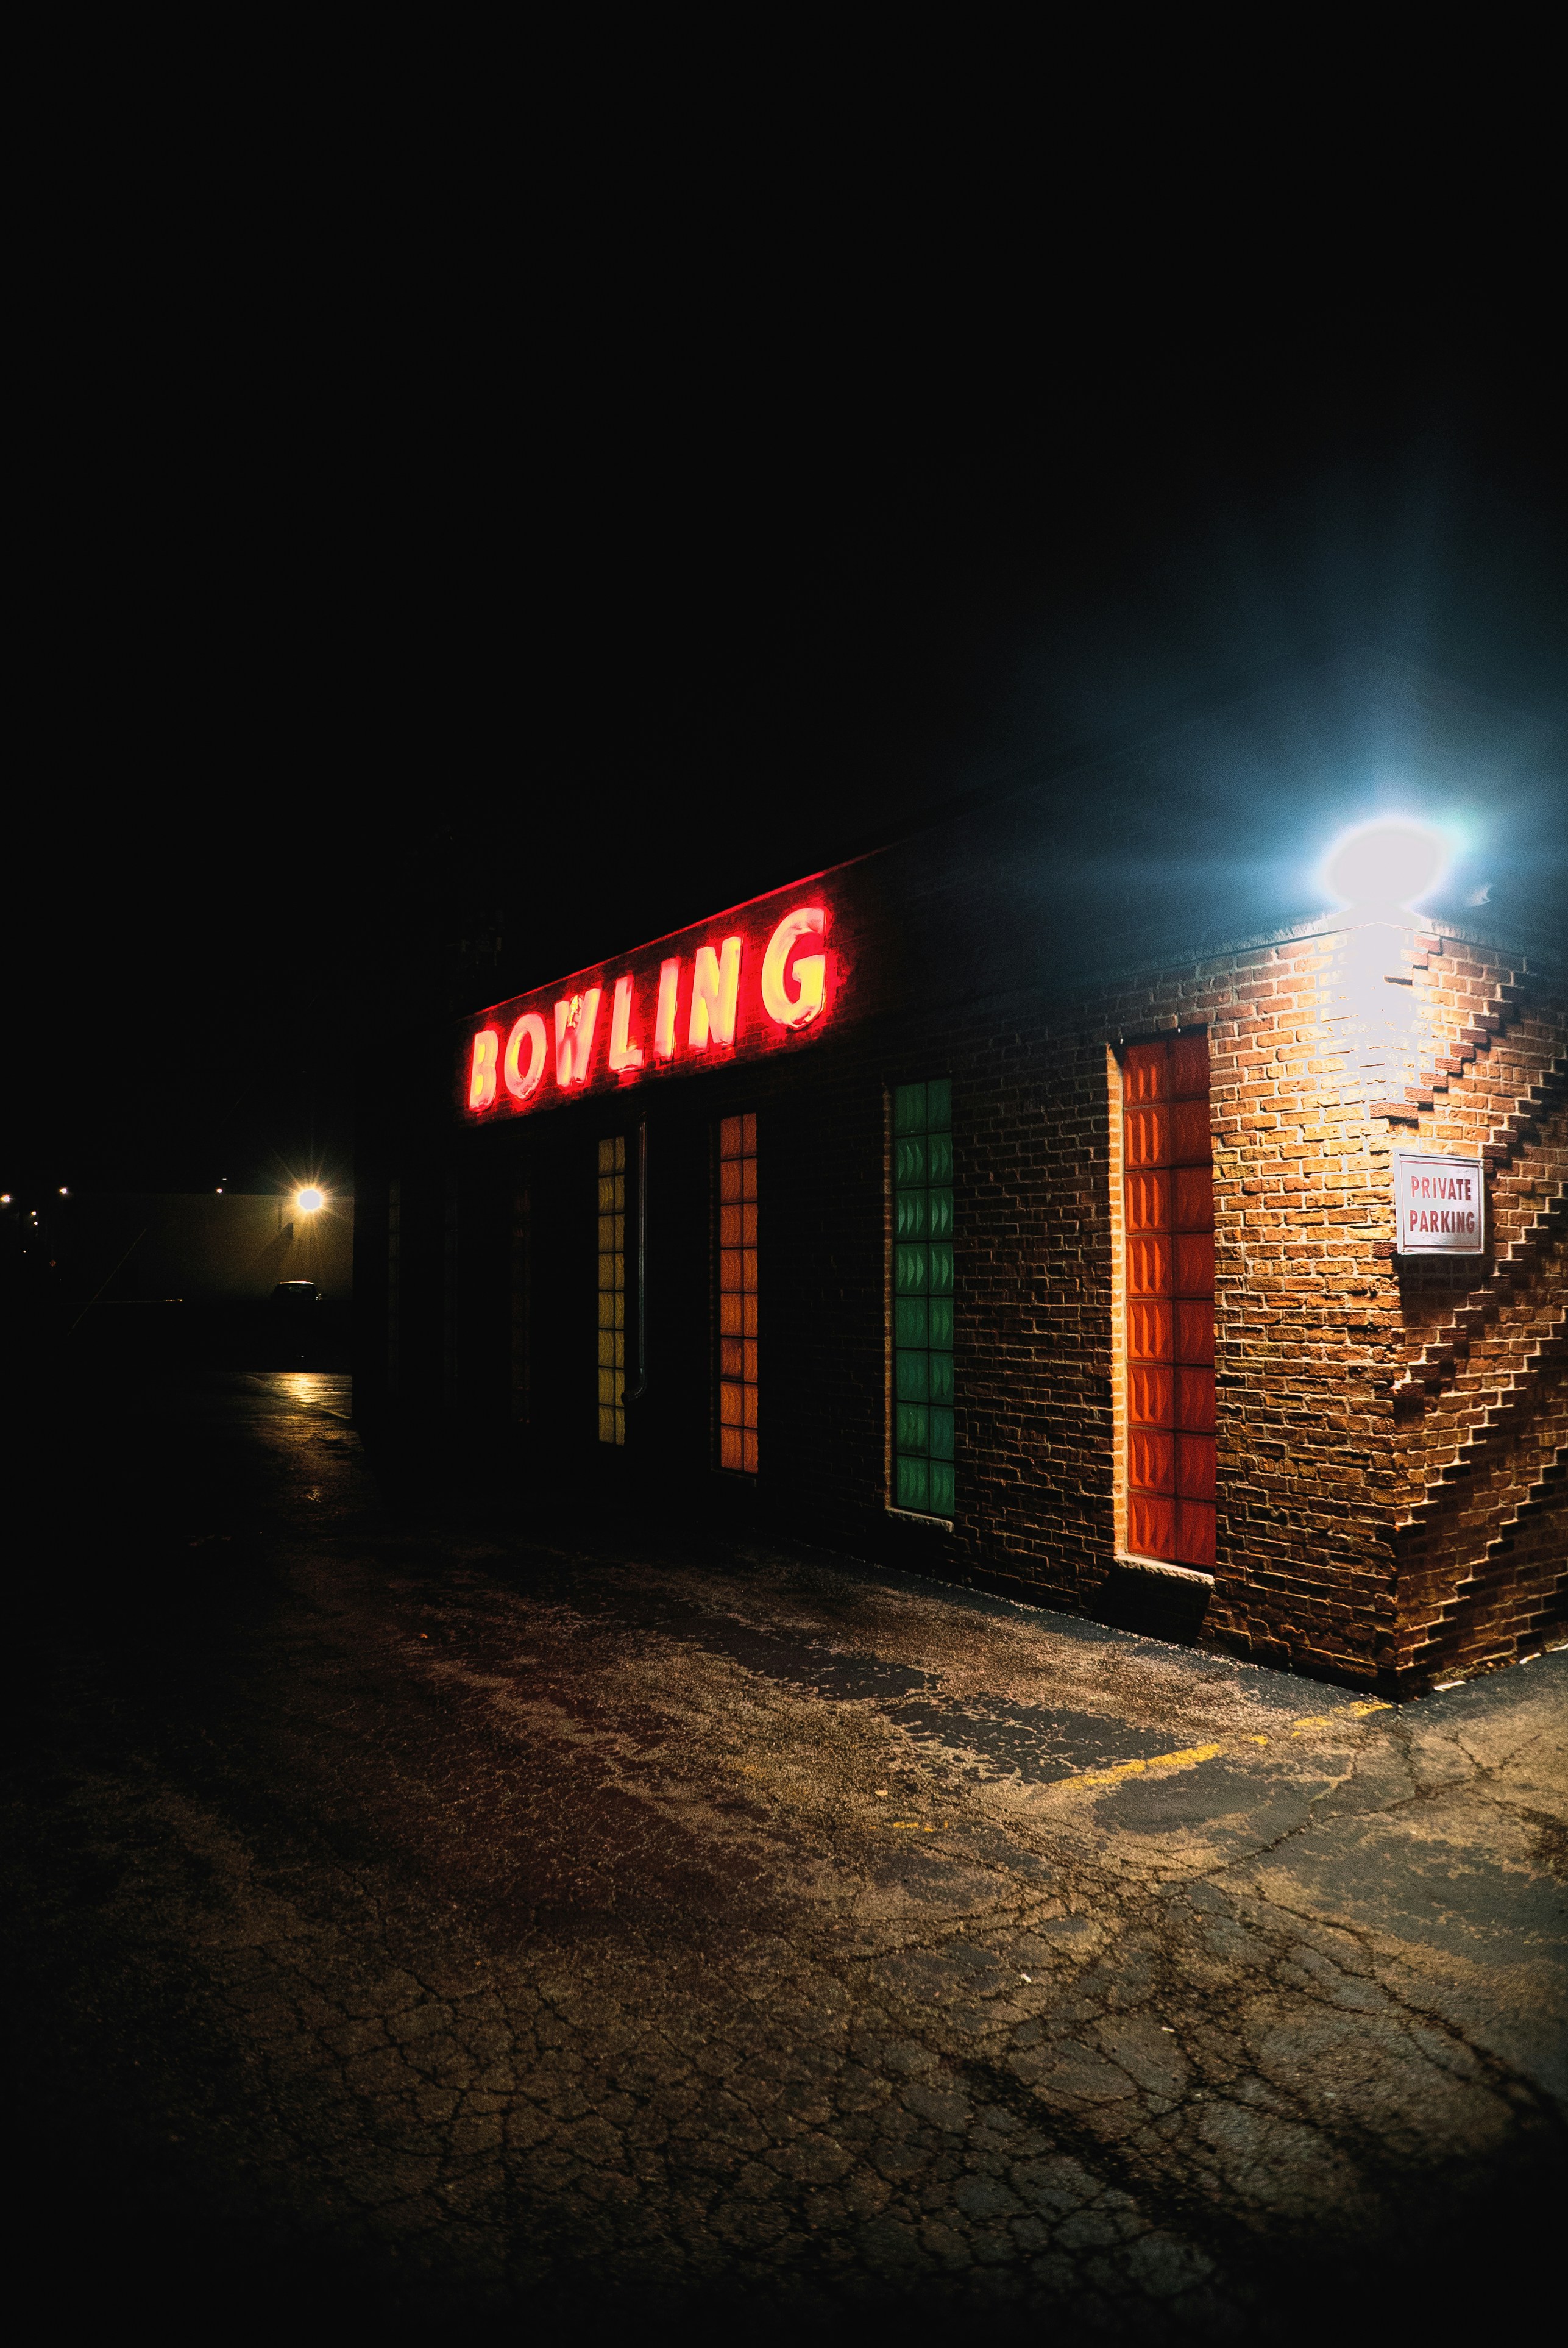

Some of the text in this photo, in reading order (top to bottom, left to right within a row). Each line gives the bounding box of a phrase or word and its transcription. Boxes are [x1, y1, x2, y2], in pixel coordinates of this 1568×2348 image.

[469, 907, 828, 1112] BOWLING
[1411, 1176, 1472, 1201] PRIVATE
[1409, 1209, 1475, 1234] PARKING
